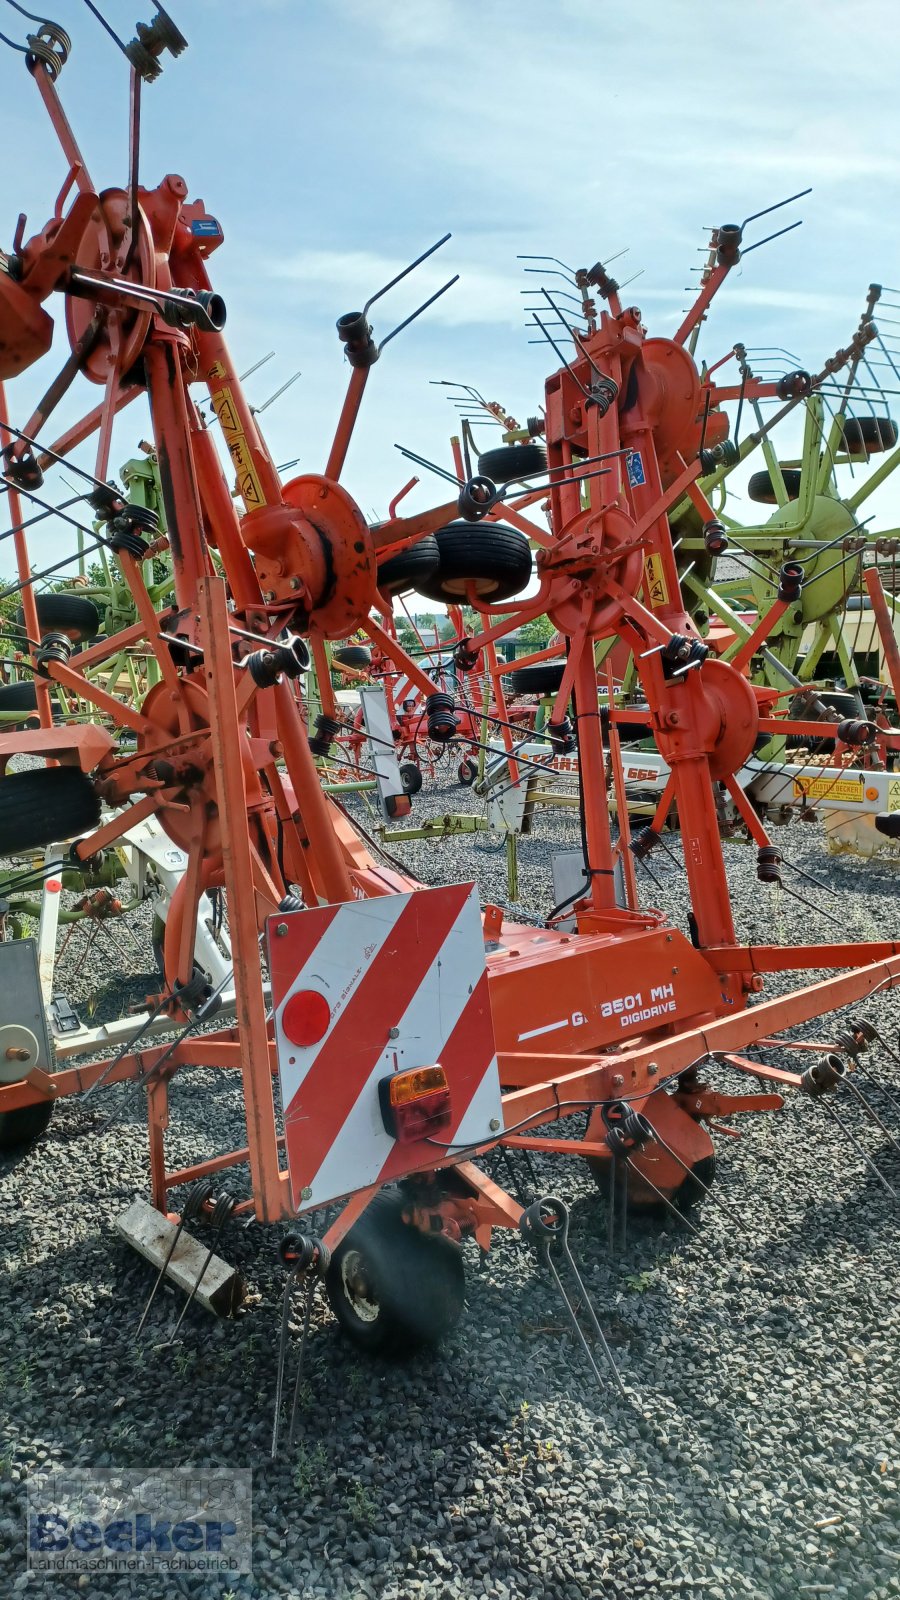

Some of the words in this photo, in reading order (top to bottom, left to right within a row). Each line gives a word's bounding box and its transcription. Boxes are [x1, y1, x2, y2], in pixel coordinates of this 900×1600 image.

[628, 768, 659, 781] 665
[835, 784, 859, 794] BECKER
[650, 983, 674, 1002] MH
[620, 1000, 677, 1027] DIGIDRIVE
